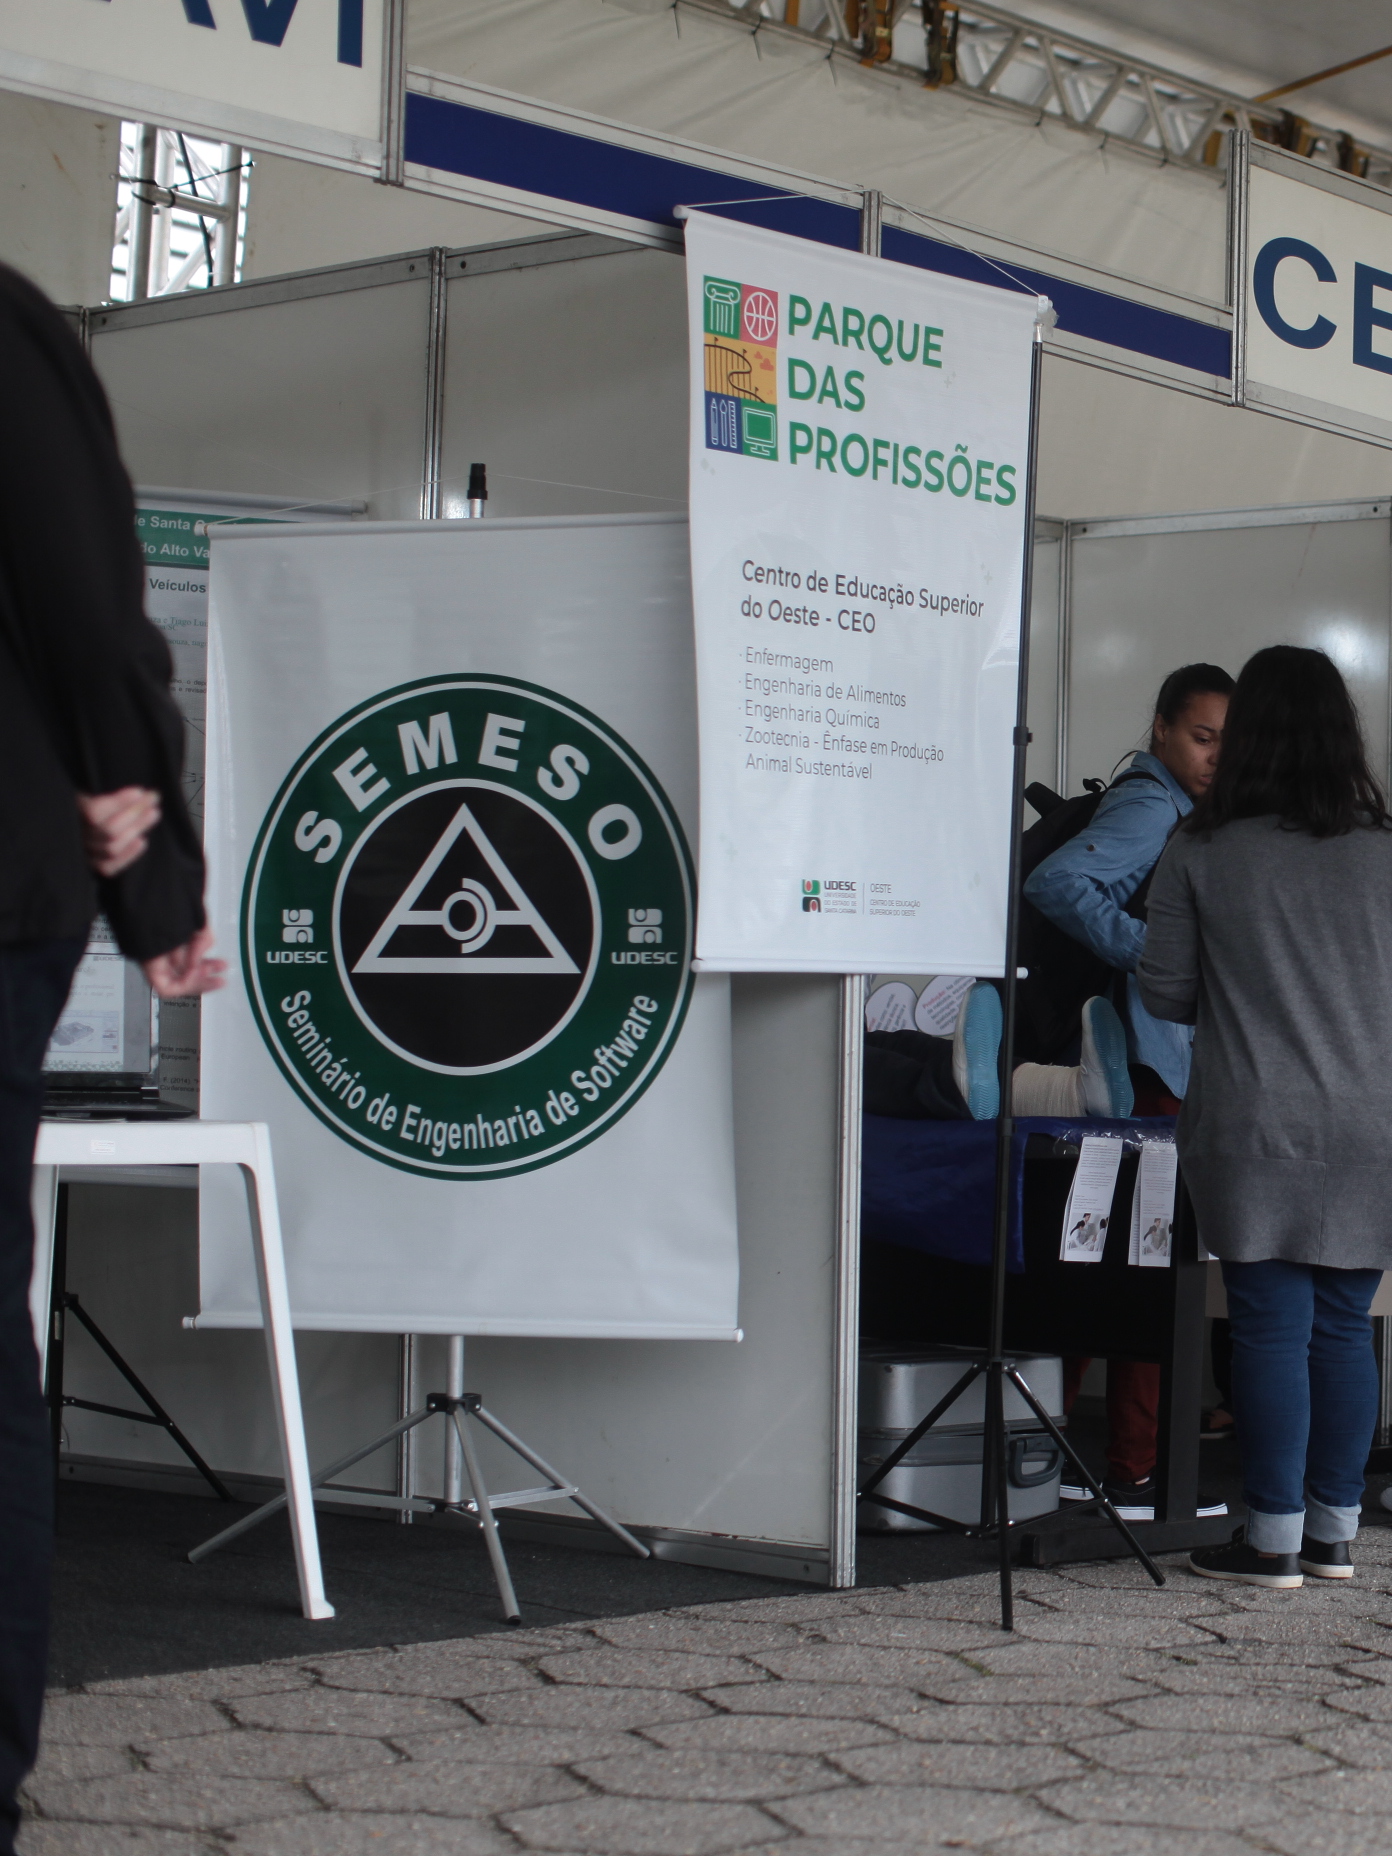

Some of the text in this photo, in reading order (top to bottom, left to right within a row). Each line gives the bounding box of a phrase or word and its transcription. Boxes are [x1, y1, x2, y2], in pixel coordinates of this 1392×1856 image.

[788, 294, 944, 368] PARQUE
[787, 357, 866, 413] DAS
[789, 421, 1017, 507] PROFISSÕES
[150, 516, 190, 530] Santa
[160, 543, 189, 557] Alto
[149, 578, 206, 594] Veículos
[742, 559, 984, 618] Centro de Educação Superior
[740, 595, 762, 619] do
[768, 599, 820, 627] Oeste
[838, 609, 876, 634] CEO
[746, 646, 834, 675] Enfermagem
[745, 673, 907, 708] Engenharia de Alimentos
[745, 699, 880, 730] Engenharia Química
[745, 726, 810, 750] Zootecnia
[823, 730, 867, 755] Ênfase
[870, 742, 888, 756] em
[891, 740, 944, 765] Produção
[745, 753, 872, 780] Animal Sustentável
[295, 711, 643, 864] SEMESO
[824, 881, 857, 891] UDESC
[870, 883, 892, 894] OESTE
[266, 951, 328, 964] UDESC
[611, 951, 678, 965] UDESC
[281, 990, 659, 1157] Seminário de Engenharia de Software
